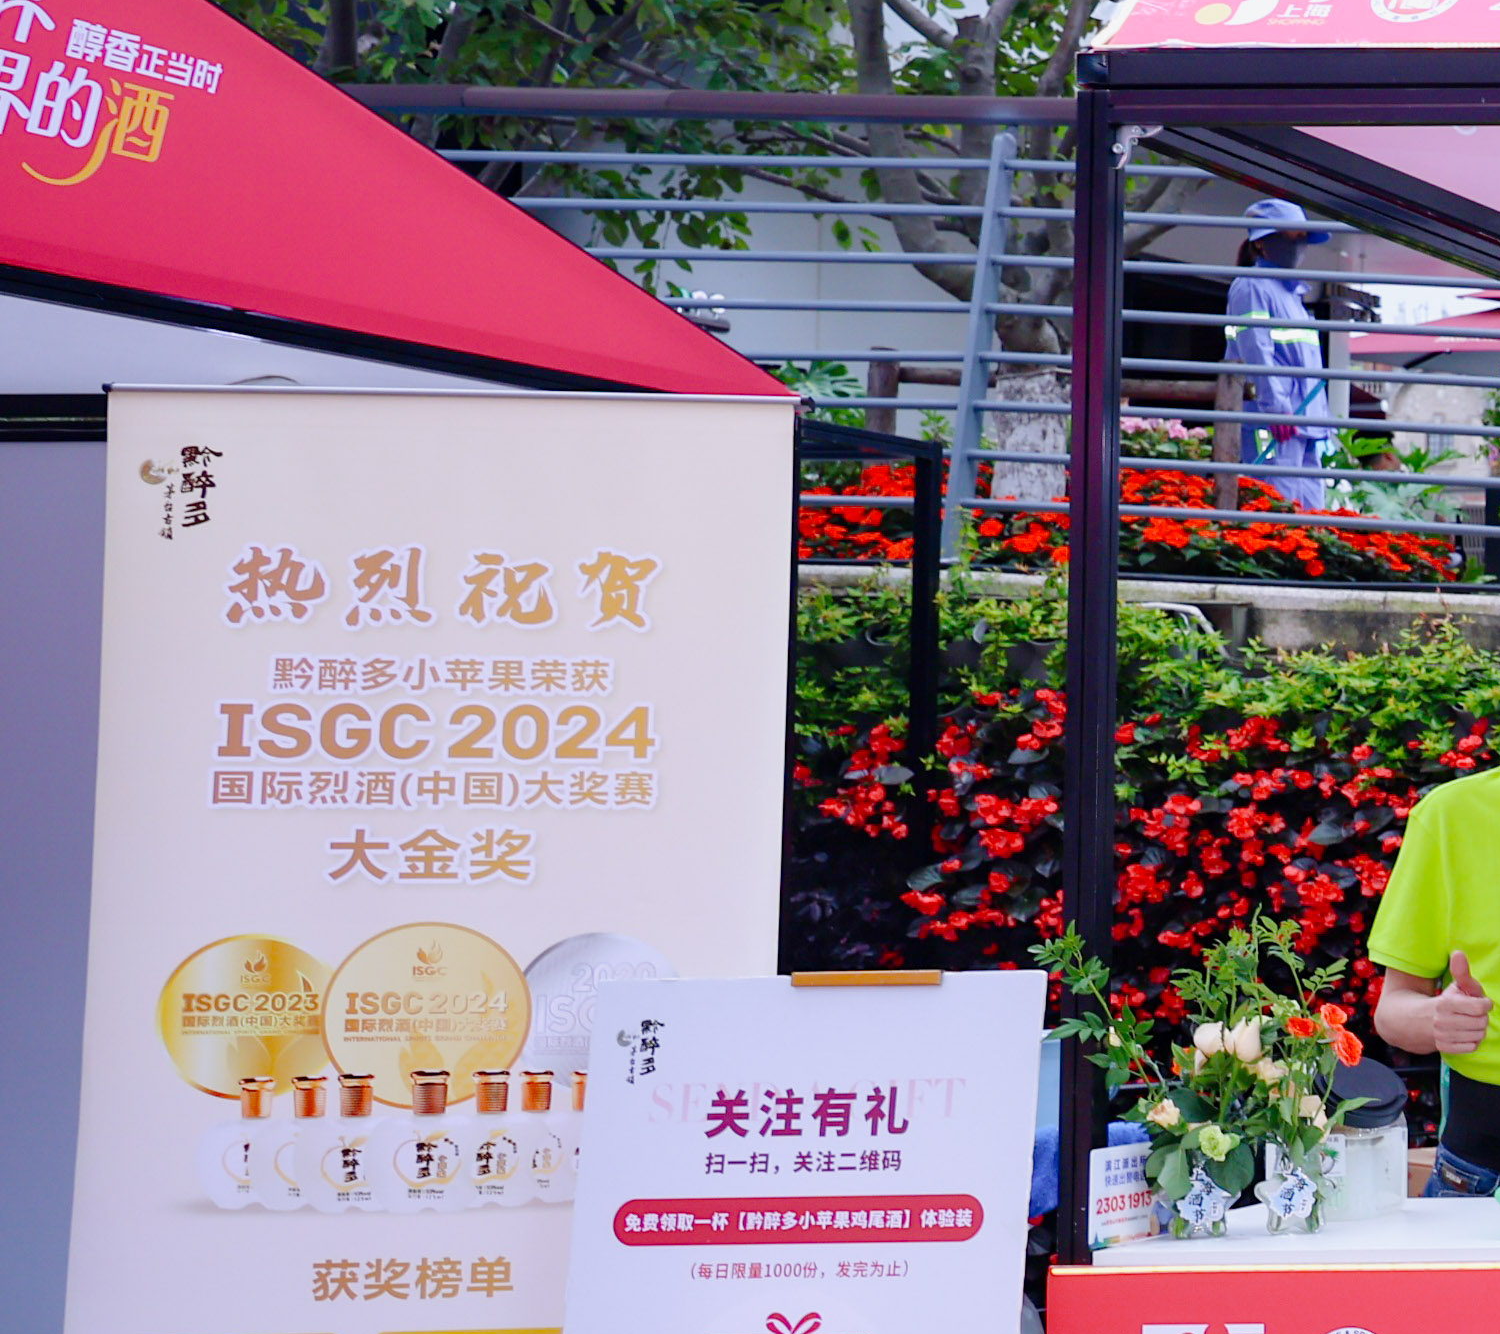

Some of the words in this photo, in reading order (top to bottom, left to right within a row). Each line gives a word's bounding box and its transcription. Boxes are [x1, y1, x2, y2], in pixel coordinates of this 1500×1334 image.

[1277, 4, 1332, 18] 上海
[66, 18, 223, 94] 醇香正当时
[181, 445, 223, 527] 黔醉多
[226, 546, 658, 629] 热烈祝贺
[272, 657, 611, 693] 黔醉多小苹果荣获
[216, 703, 431, 760] ISGC
[447, 703, 656, 760] 2024
[210, 769, 656, 808] 国际烈酒(中国)大奖赛
[328, 828, 533, 882] 大金奖
[182, 994, 249, 1013] ISGC
[255, 994, 319, 1013] 2023
[345, 992, 424, 1015] ISGC
[428, 990, 509, 1015] 2024
[705, 1086, 910, 1139] 关注有礼
[705, 1149, 902, 1175] 扫一扫，关注二维码
[624, 1207, 974, 1233] 免费领取一杯【黔醉多小苹果鸡尾酒】体验装
[1096, 1194, 1126, 1215] 2303
[312, 1256, 513, 1301] 获奖榜单
